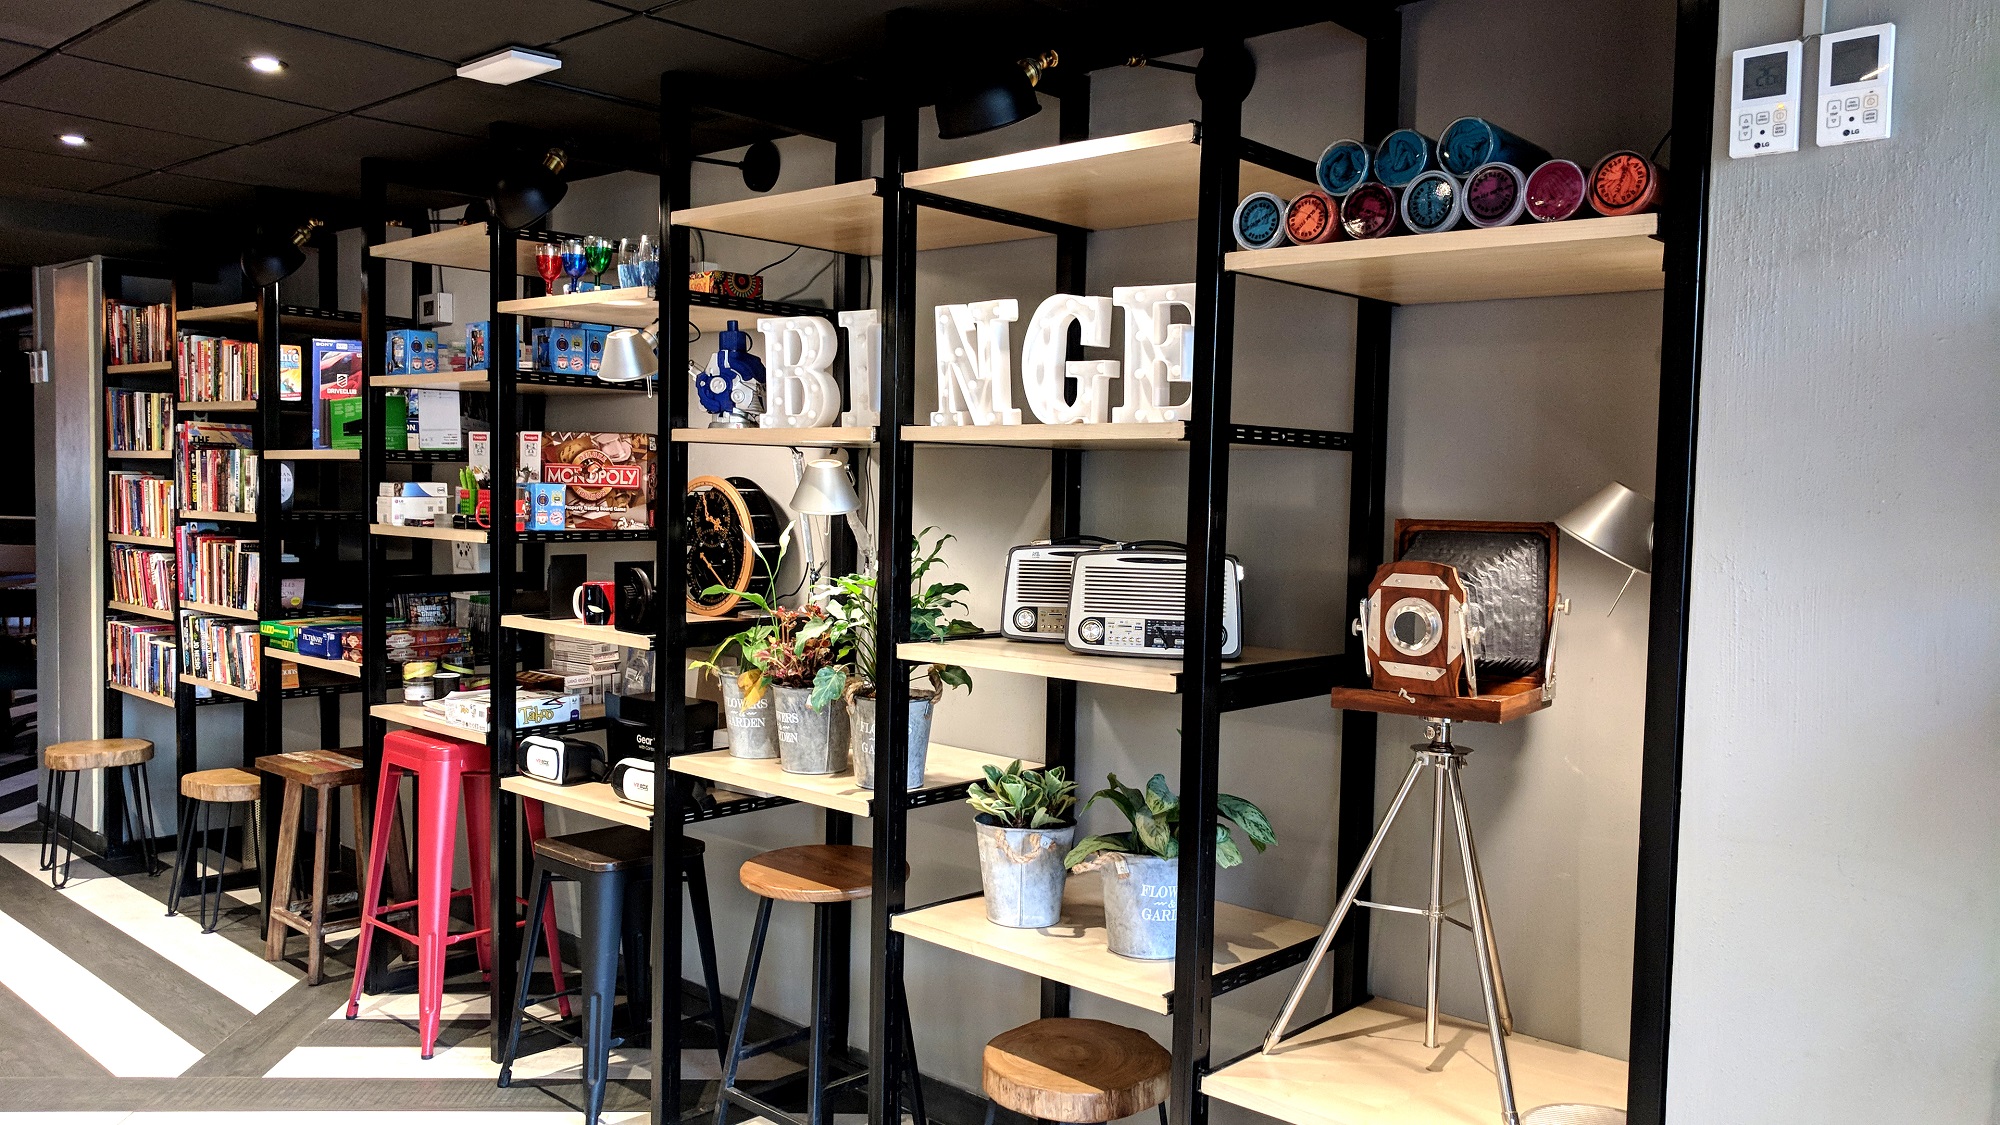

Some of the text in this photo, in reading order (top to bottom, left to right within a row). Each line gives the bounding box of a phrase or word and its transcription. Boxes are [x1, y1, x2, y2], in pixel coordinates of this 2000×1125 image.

[757, 283, 1196, 429] BINGE
[191, 435, 210, 443] THE
[547, 467, 637, 485] MONOPOLY
[519, 705, 554, 725] Taboo
[636, 734, 653, 745] Gear
